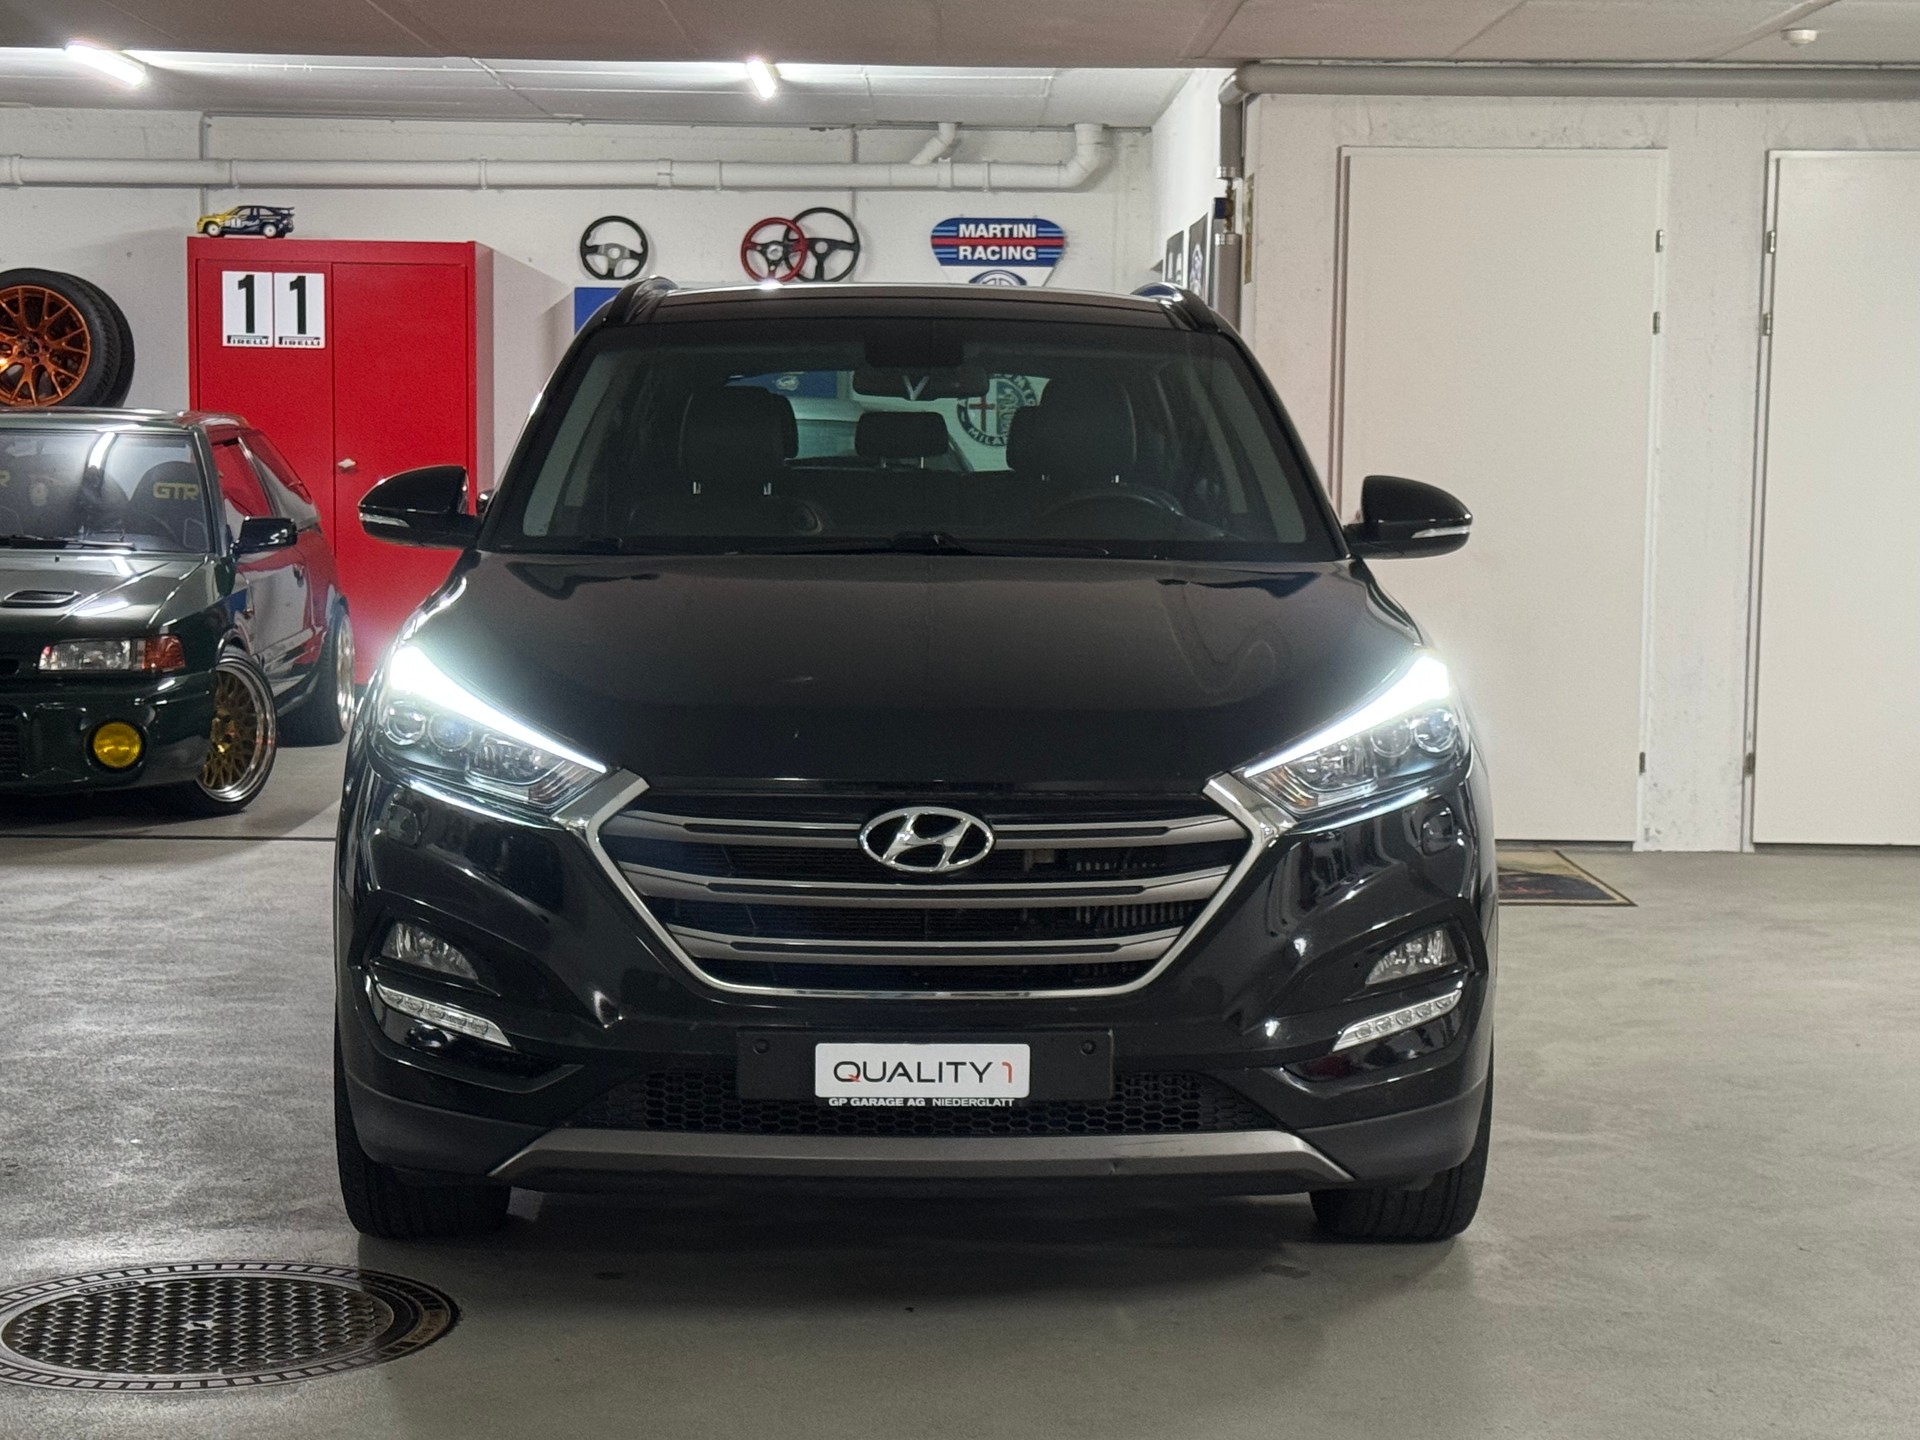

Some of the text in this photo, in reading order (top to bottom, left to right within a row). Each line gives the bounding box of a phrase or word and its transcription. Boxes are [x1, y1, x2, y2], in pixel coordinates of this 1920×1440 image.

[958, 223, 1037, 238] MARTINI
[958, 245, 1037, 261] RACING
[152, 482, 200, 501] GTR
[833, 1060, 993, 1083] QUALITY
[828, 1098, 1015, 1107] GP GARAGE AG NIEDERGLATT
